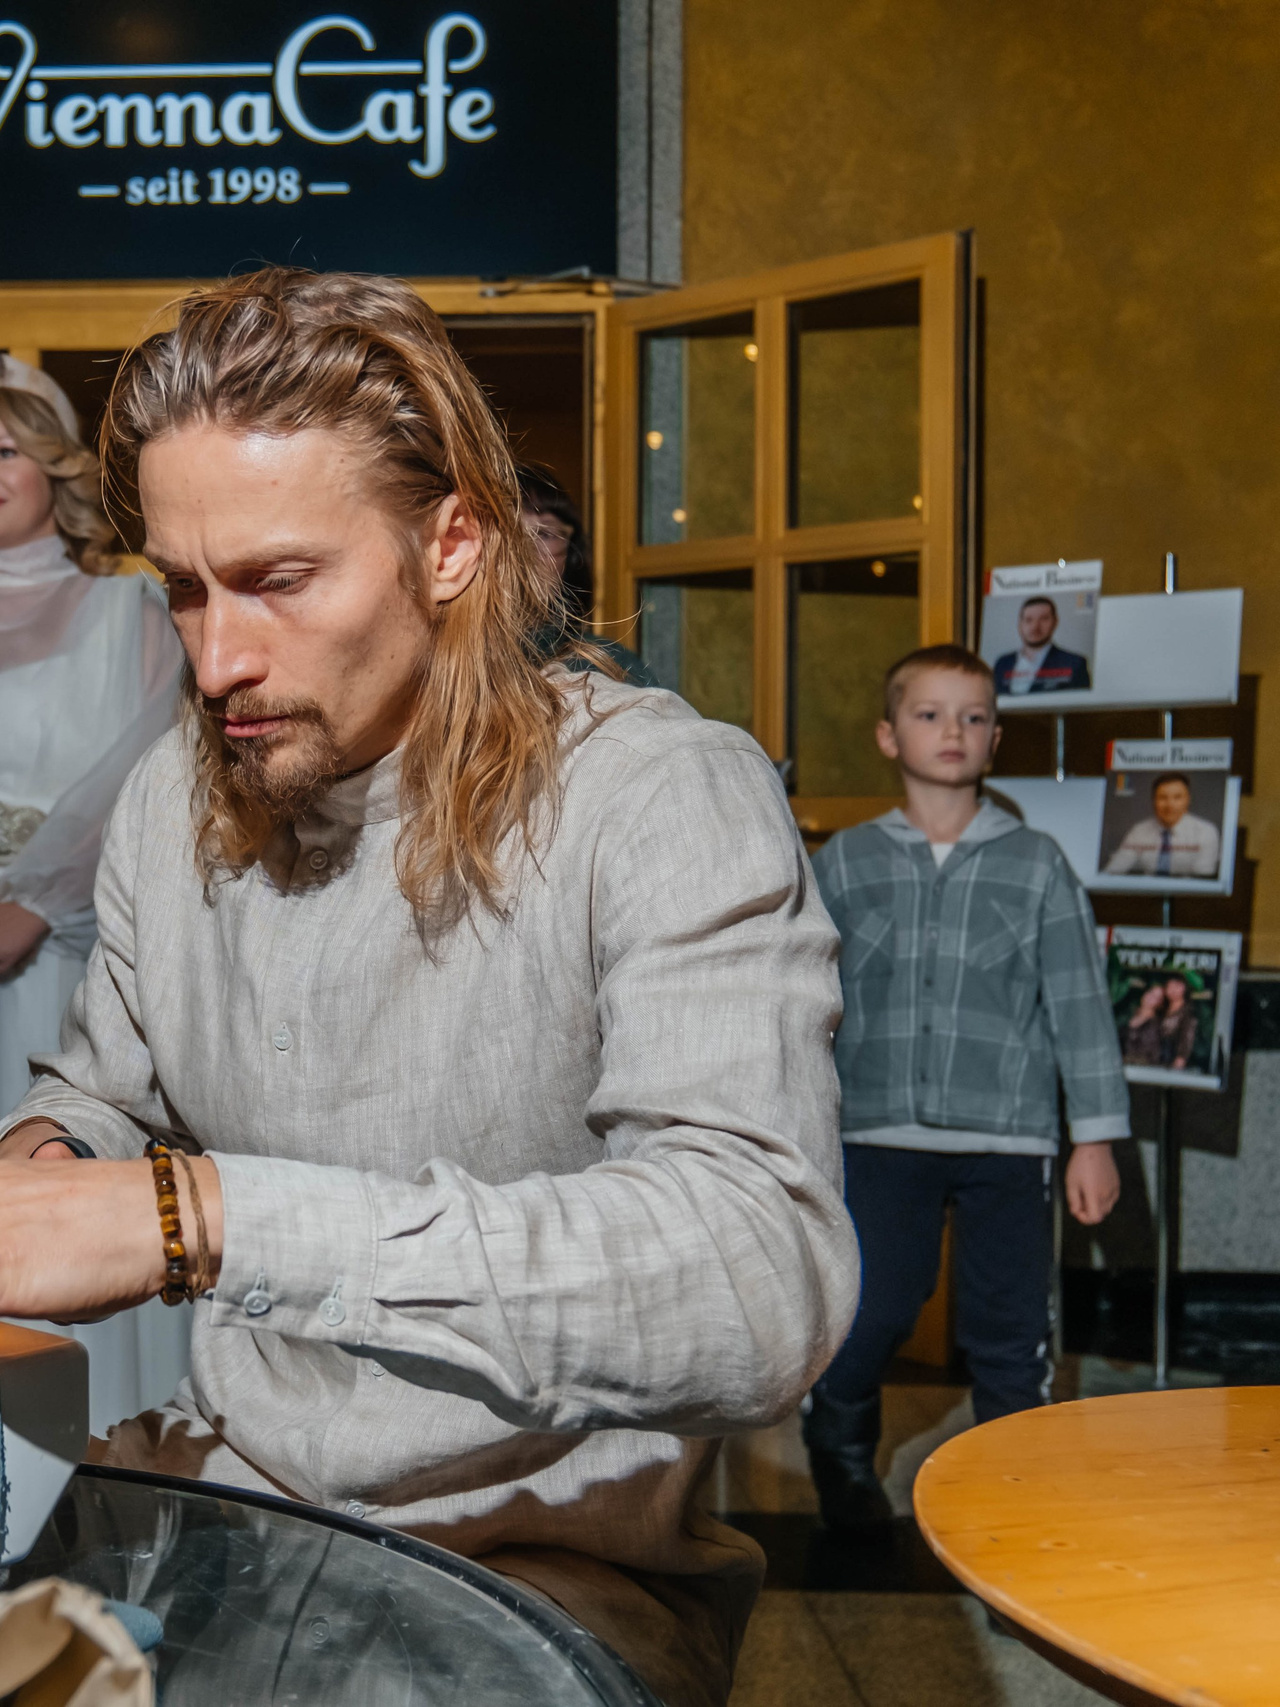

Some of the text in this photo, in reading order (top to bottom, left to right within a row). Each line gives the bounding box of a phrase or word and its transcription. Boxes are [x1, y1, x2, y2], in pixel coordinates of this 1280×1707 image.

[273, 13, 497, 178] Cafe
[125, 166, 303, 206] seit 1998
[1116, 949, 1168, 969] VERY
